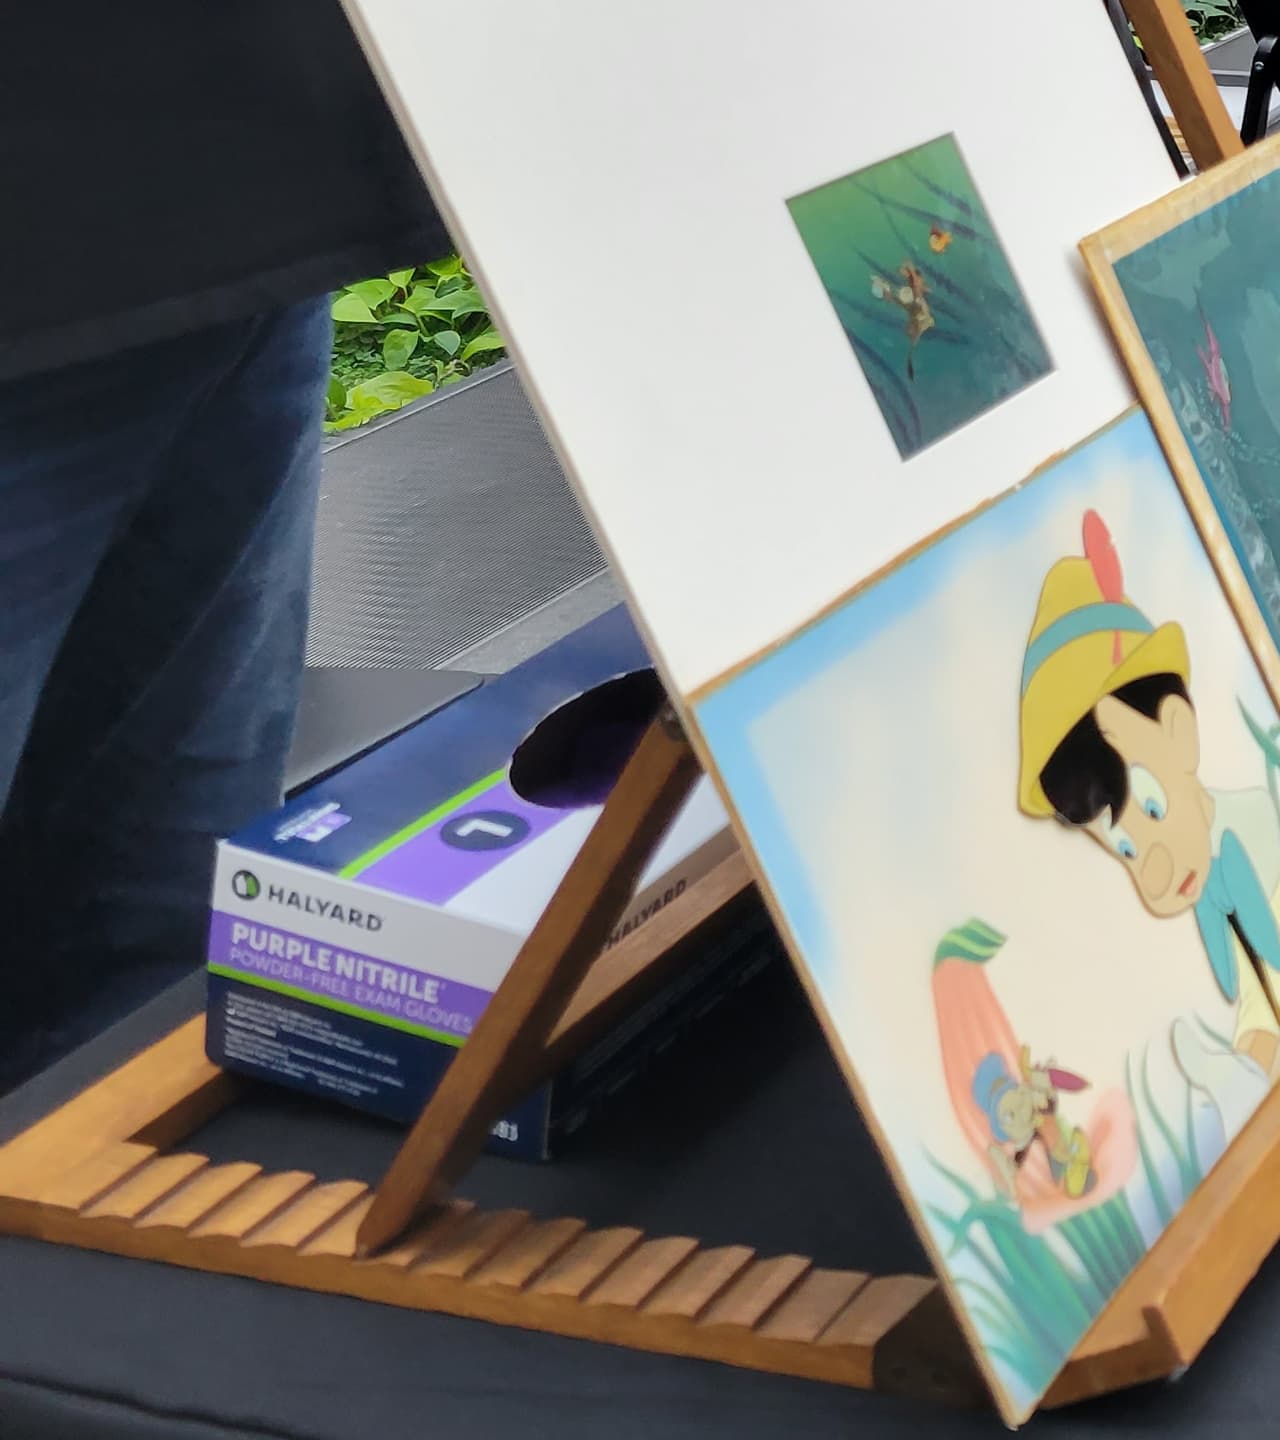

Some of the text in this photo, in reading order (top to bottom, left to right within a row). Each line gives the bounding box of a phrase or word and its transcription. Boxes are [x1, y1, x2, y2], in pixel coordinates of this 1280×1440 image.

[267, 883, 386, 933] HALYARD
[230, 921, 440, 1004] PURPLE NITRILE
[230, 948, 350, 1003] POWDER-FREE
[354, 981, 401, 1014] EXAM
